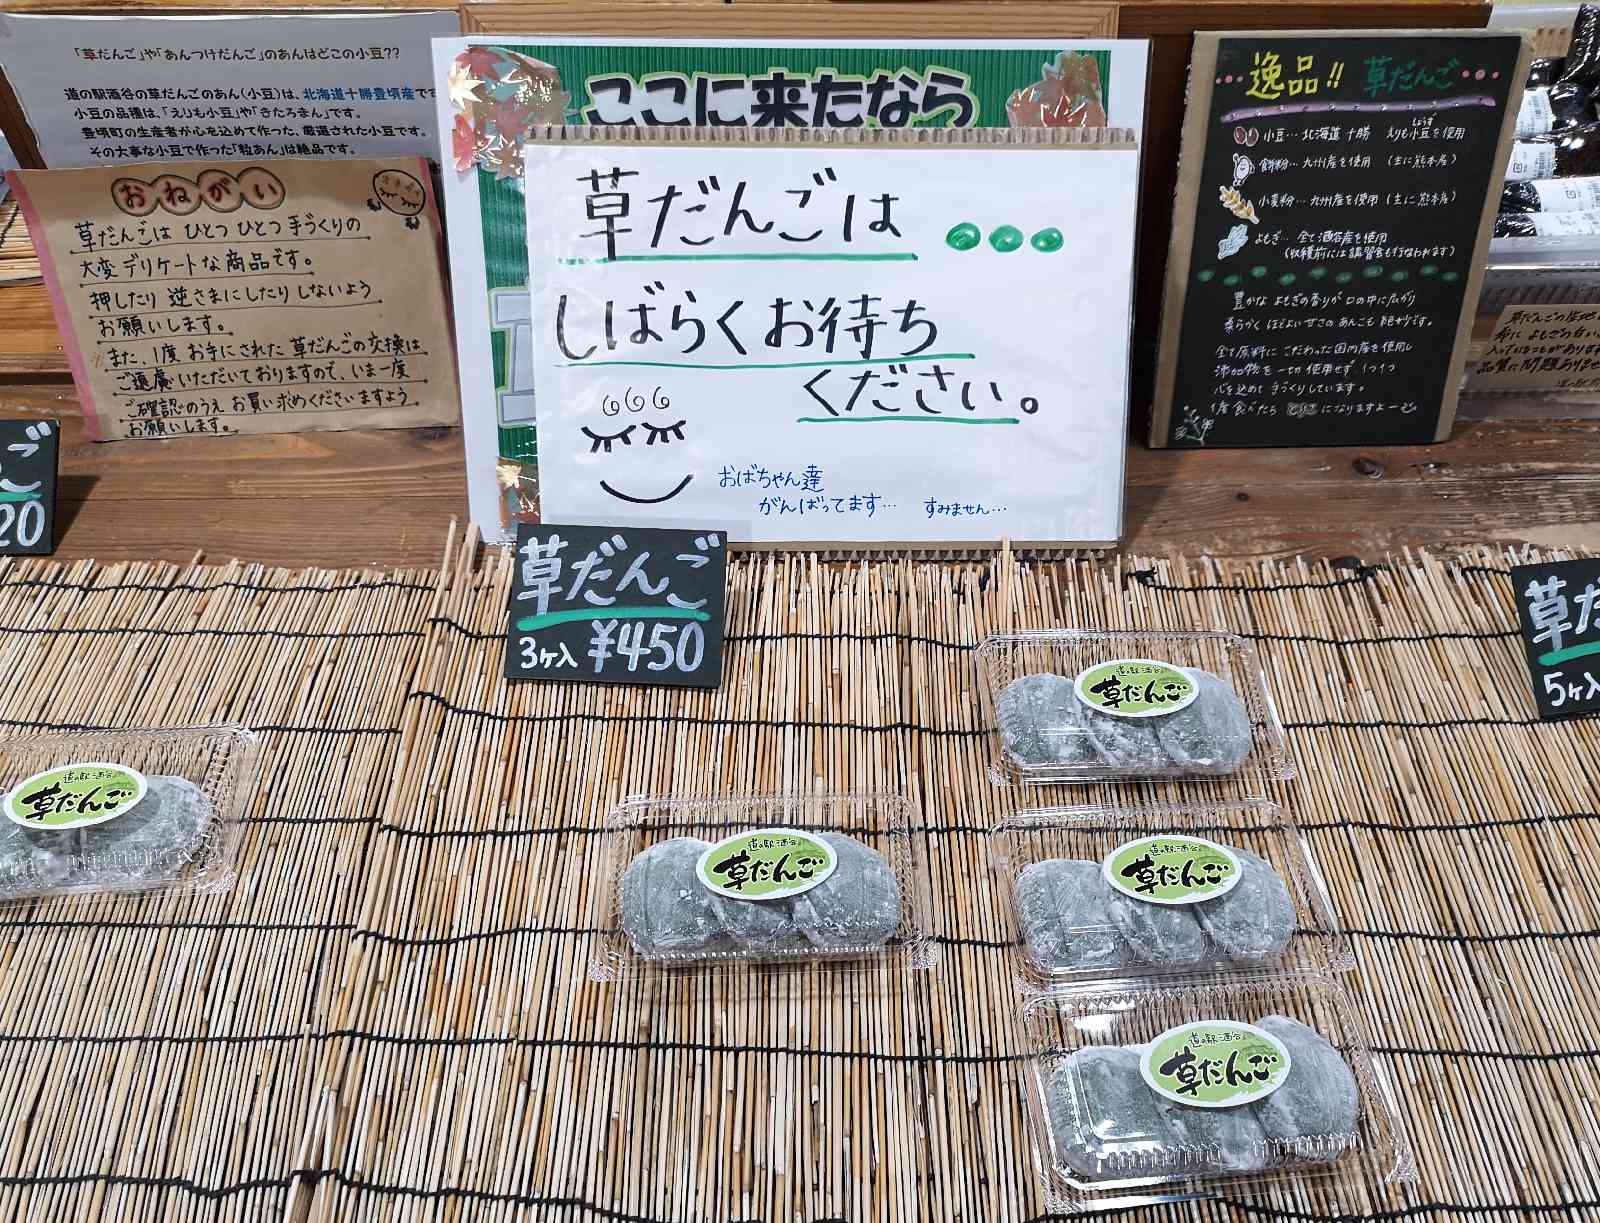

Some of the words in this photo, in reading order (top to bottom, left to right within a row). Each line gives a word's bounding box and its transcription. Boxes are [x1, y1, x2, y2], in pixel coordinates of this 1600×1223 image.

[1361, 56, 1461, 98] 草だんご
[585, 70, 975, 128] ここに来たなら
[118, 178, 281, 209] おねがい
[576, 166, 903, 262] 草だんごは
[97, 313, 225, 338] お願いします。
[555, 280, 940, 361] しばらくお待ち
[803, 363, 1040, 417] ください。
[129, 416, 230, 437] お願いします。
[717, 463, 826, 493] おばちゃん達
[516, 533, 721, 616] 草だんご
[1089, 674, 1188, 709] 草だんご
[20, 780, 133, 821] 草だんご
[712, 849, 824, 891] 草だんご
[1120, 853, 1230, 894] 草だんご
[1158, 1046, 1278, 1096] 草だんご
